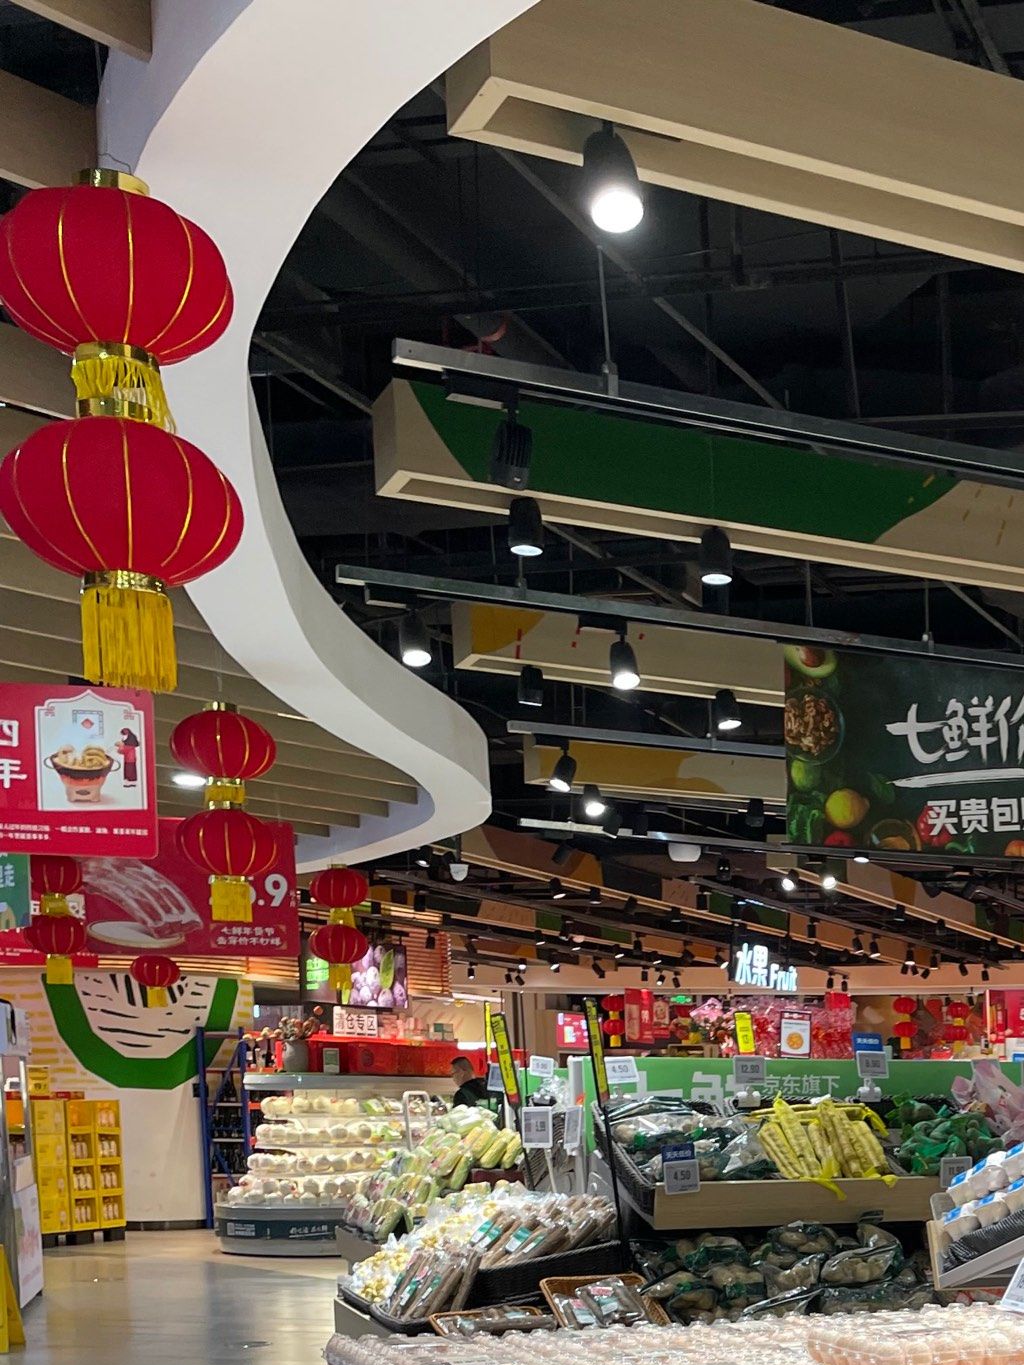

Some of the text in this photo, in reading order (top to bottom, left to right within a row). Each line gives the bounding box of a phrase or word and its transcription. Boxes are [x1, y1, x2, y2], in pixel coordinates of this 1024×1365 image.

[735, 943, 798, 991] 水果 Fruit
[761, 1074, 841, 1096] 京东旗下
